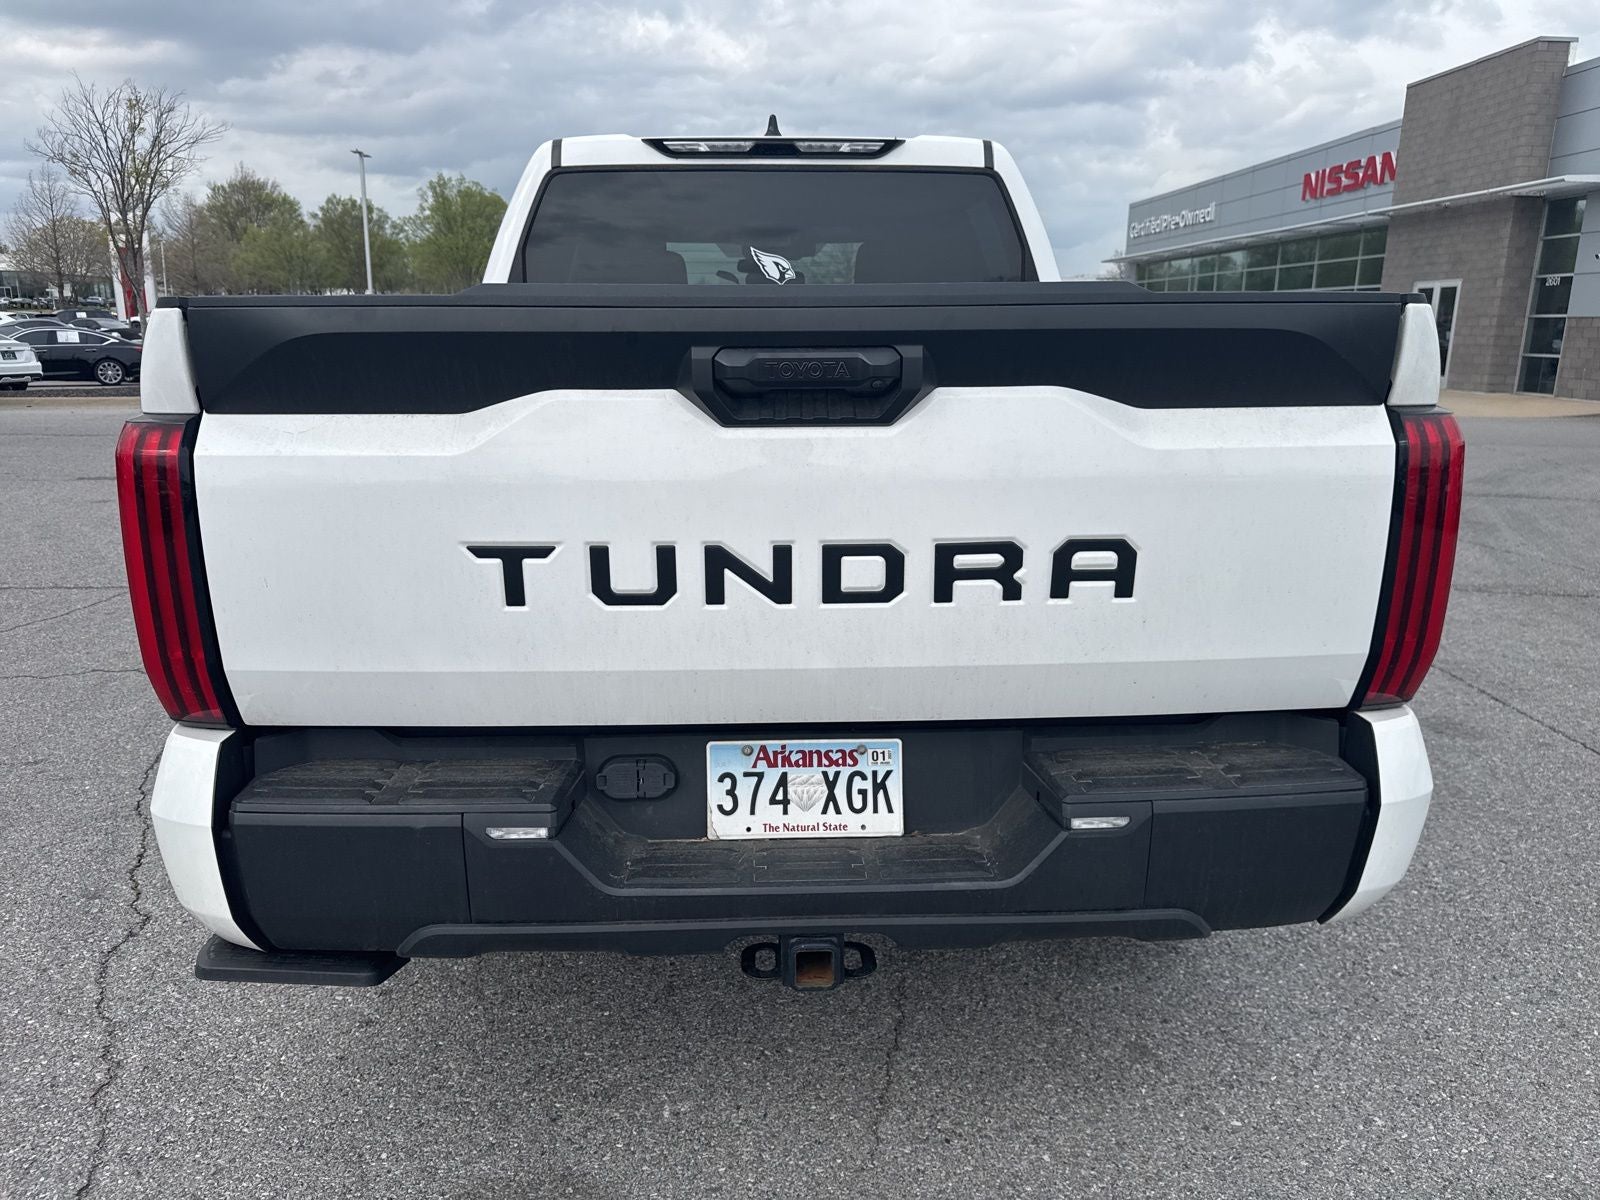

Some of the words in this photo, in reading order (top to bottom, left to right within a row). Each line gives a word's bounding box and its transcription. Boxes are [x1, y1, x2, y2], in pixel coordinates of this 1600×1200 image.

[1302, 152, 1397, 202] NISSAN
[1129, 216, 1161, 238] Certified
[1161, 201, 1216, 231] Pre-Owned
[765, 361, 851, 379] TOYOTA
[464, 538, 1139, 609] TUNDRA
[752, 744, 861, 769] Arkansas
[871, 750, 886, 762] 01
[716, 771, 791, 816] 374
[820, 769, 894, 815] XGK
[762, 823, 781, 833] The
[783, 821, 820, 833] Natural
[822, 822, 849, 832] State
